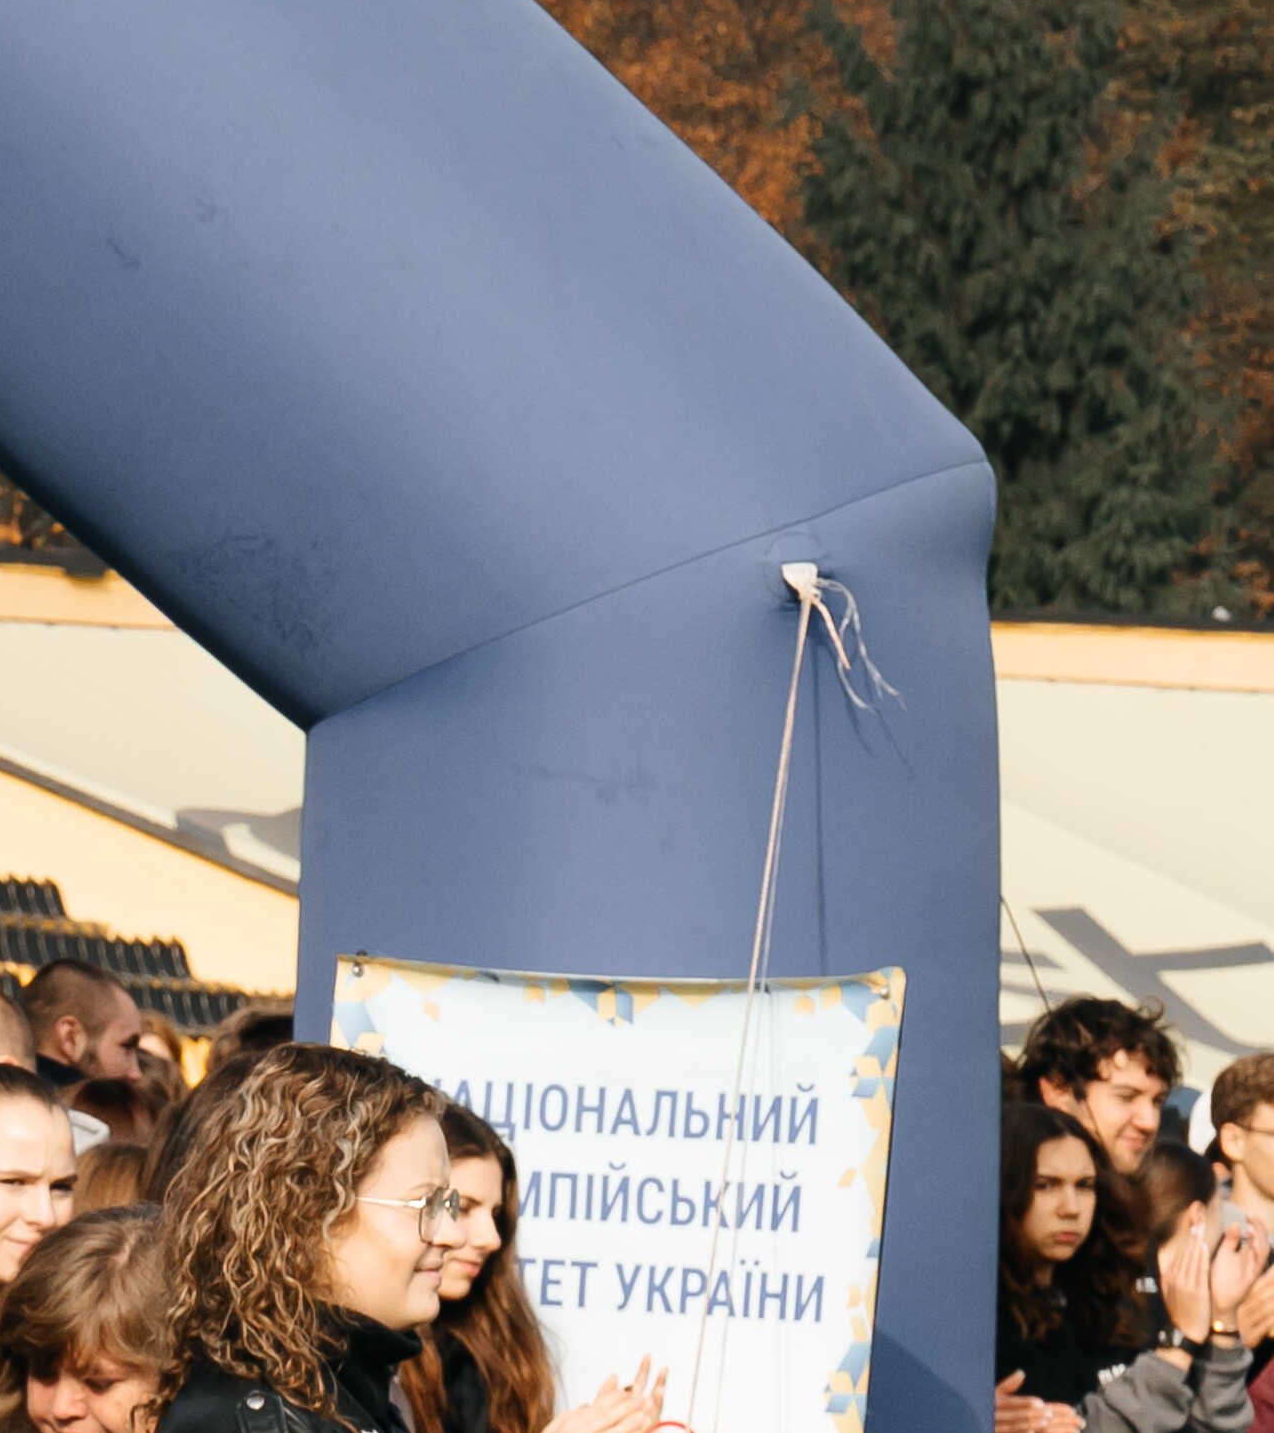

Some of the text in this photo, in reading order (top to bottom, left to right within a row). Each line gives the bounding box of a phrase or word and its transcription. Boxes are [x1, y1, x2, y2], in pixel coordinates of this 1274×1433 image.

[433, 1077, 820, 1145] АЦІОНАЛЬНИЙ
[518, 1162, 802, 1233] МПІЙСЬКИЙ
[517, 1258, 825, 1324] ТЕТ УКРАЇНИ
